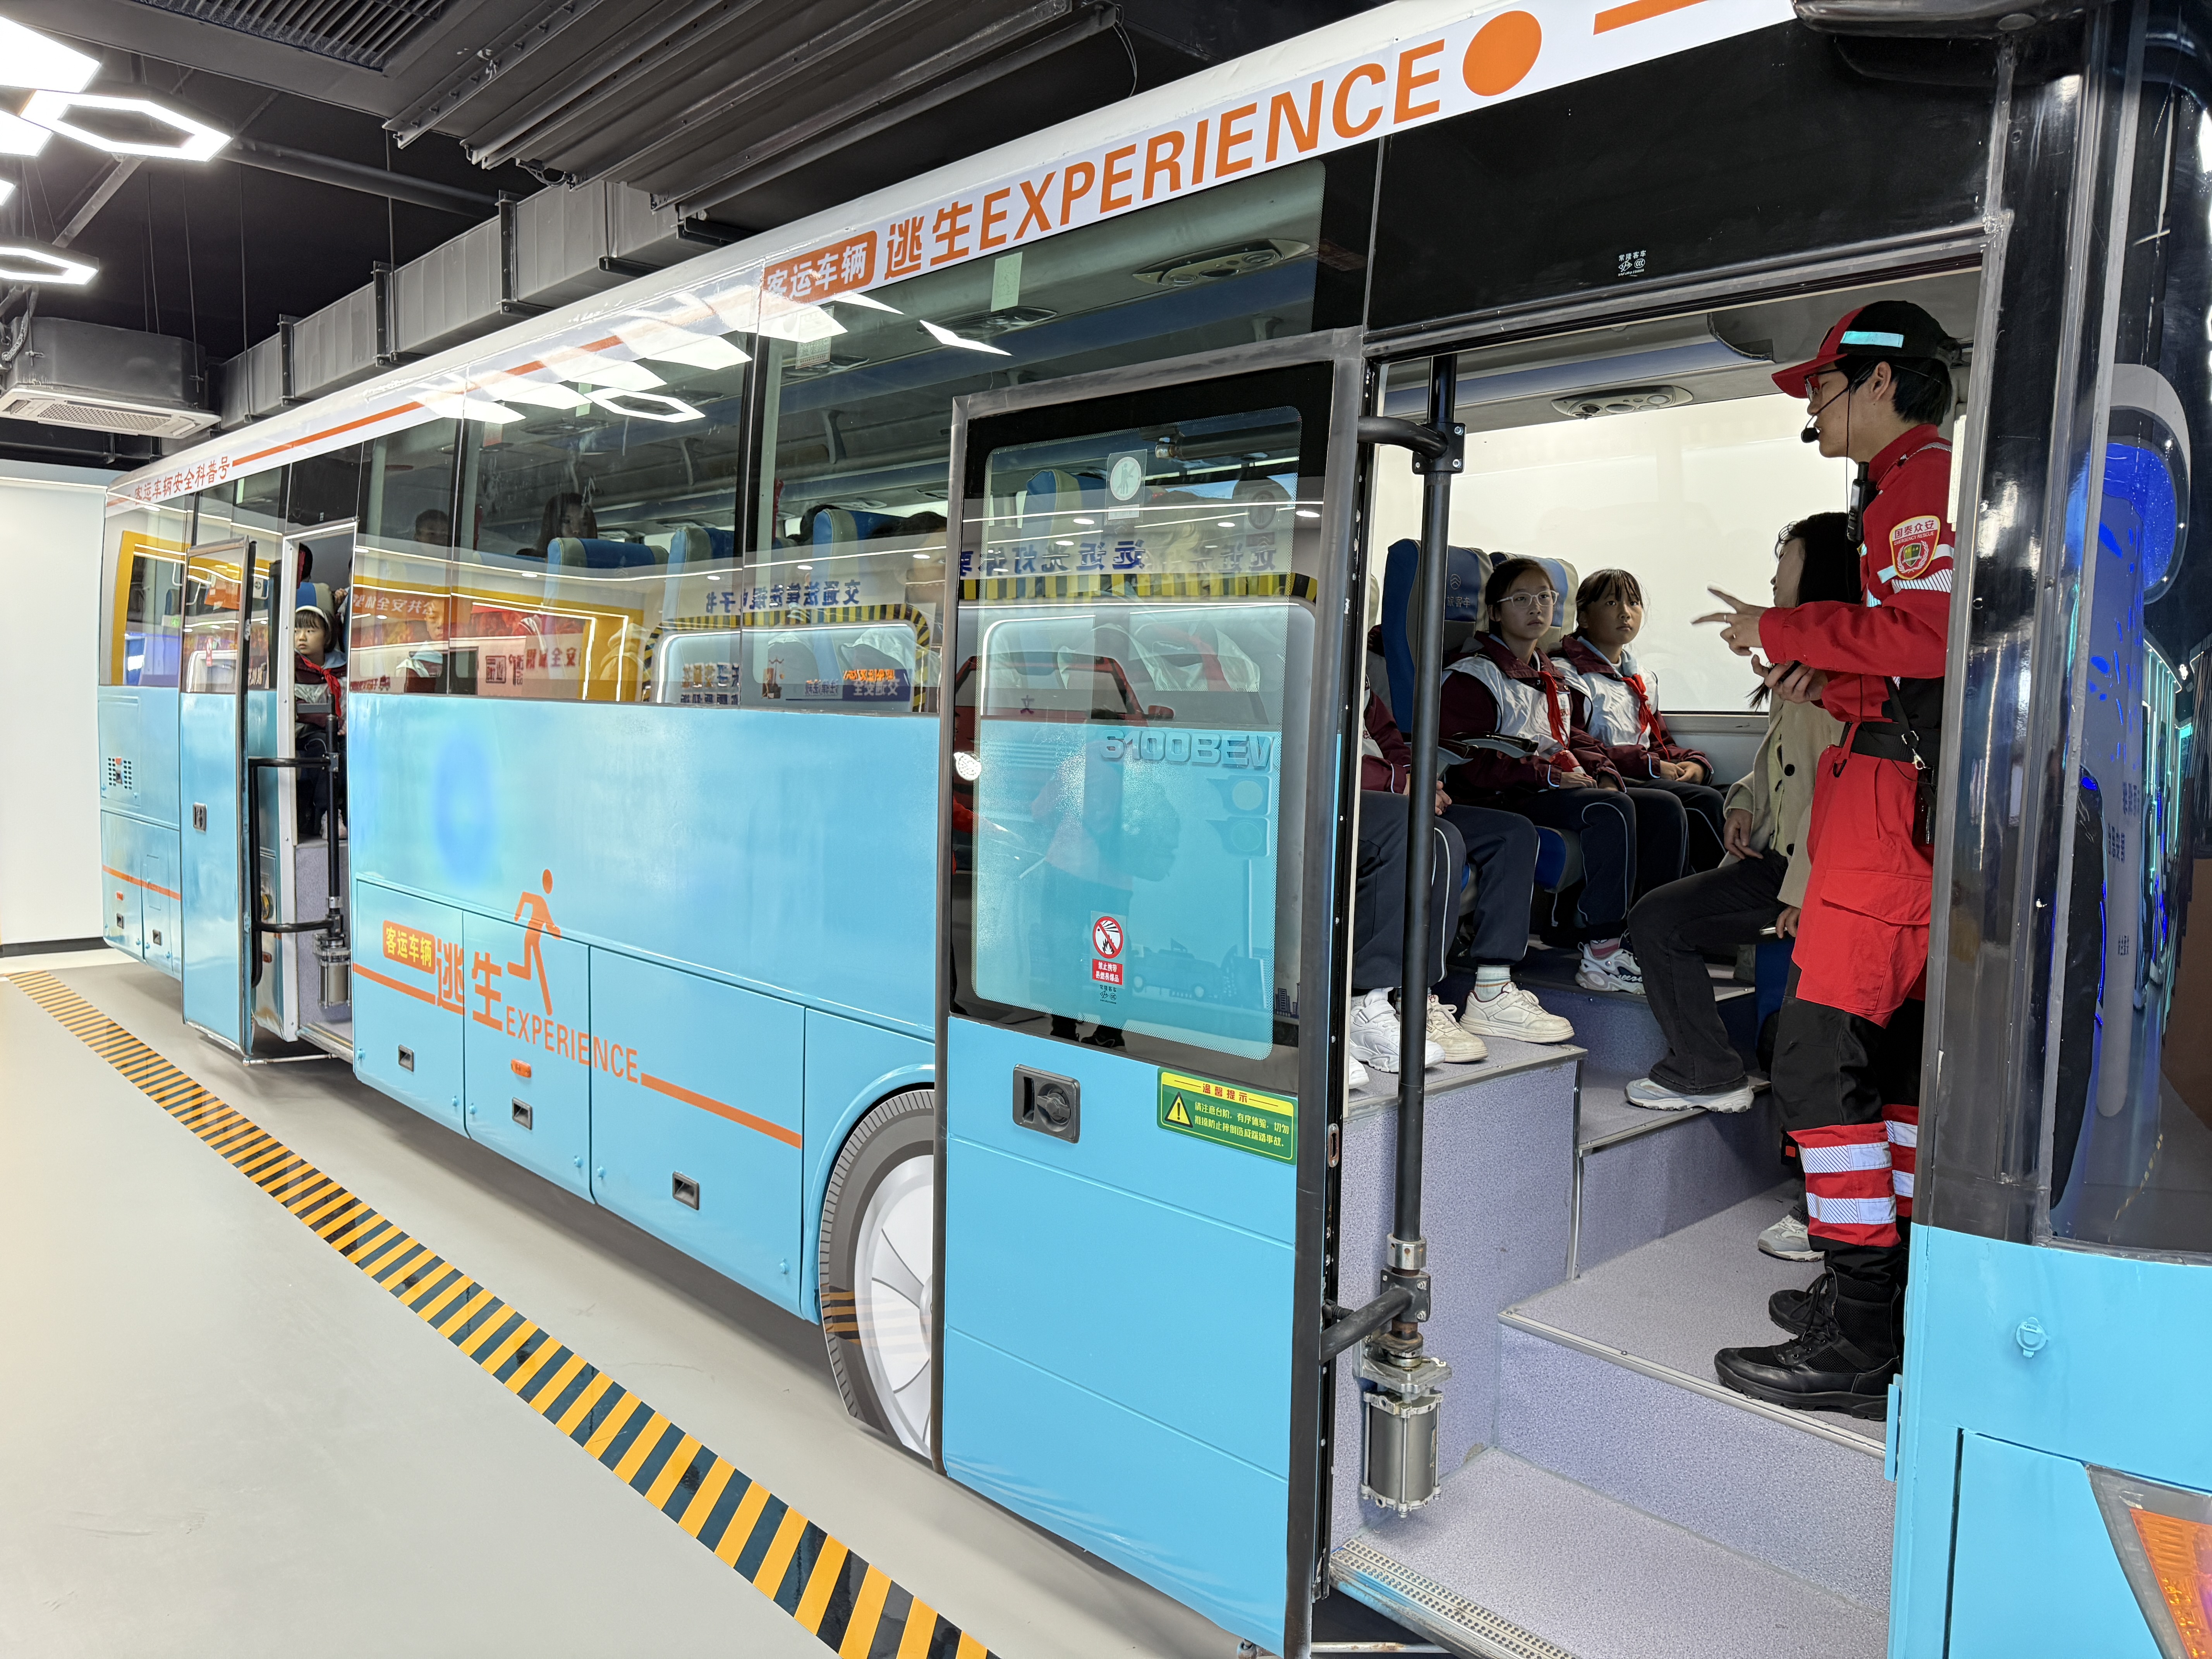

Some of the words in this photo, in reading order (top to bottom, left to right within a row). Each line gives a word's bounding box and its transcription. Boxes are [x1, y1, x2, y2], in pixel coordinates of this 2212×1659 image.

[766, 242, 867, 298] 客运车辆
[884, 201, 973, 280] 逃生
[979, 38, 1445, 251] EXPERIENCE
[135, 456, 230, 505] 客运车辆安全科普号
[1894, 520, 1934, 539] 国泰众安
[1100, 729, 1274, 768] 6100BEV
[1096, 970, 1119, 982] 易燃易爆品
[1098, 961, 1117, 972] 禁止携带
[386, 926, 432, 967] 客运车辆
[436, 938, 503, 1032] 逃生
[506, 1005, 638, 1084] EXPERIENCE
[1202, 1083, 1247, 1103] 温馨提示
